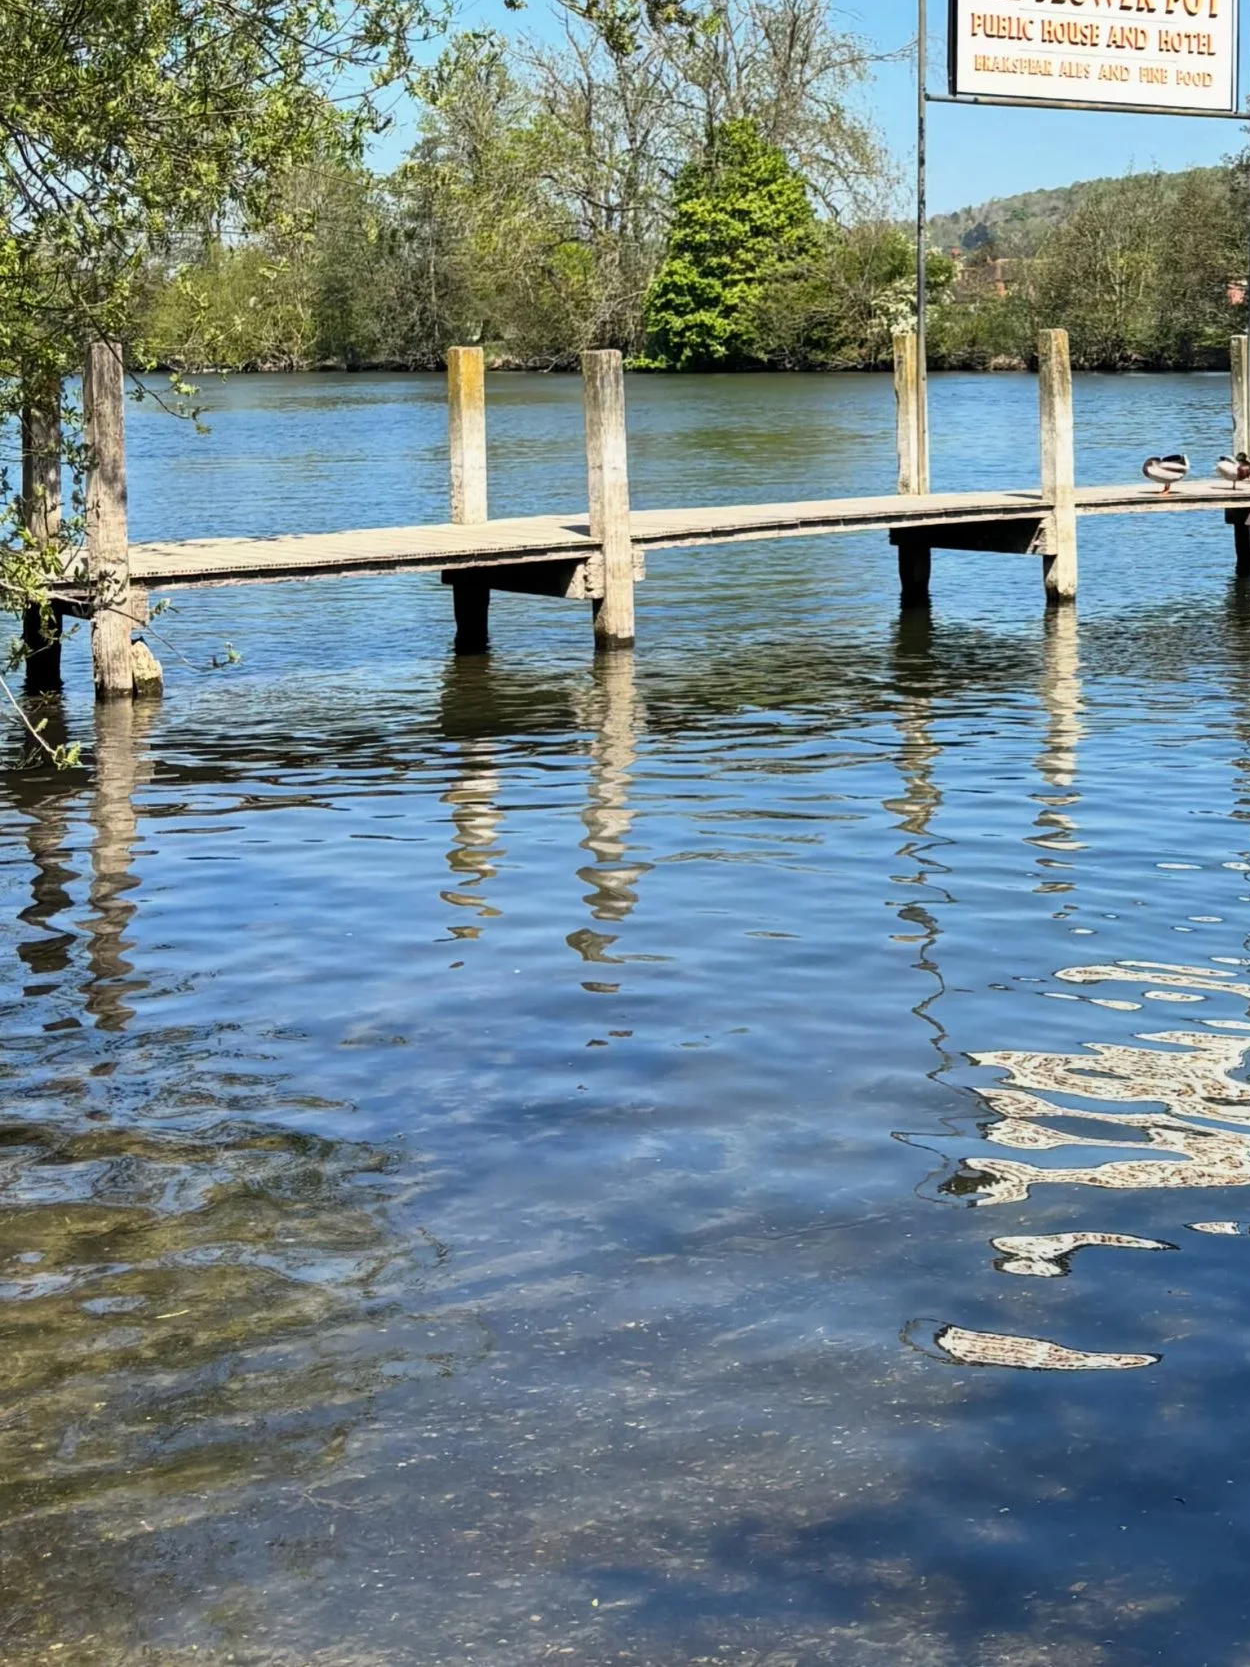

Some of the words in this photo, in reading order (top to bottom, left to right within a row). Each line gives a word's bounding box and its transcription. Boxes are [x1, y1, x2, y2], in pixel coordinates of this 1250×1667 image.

[971, 13, 1034, 41] PUBLIC
[1041, 19, 1099, 47] HOUSE
[1106, 26, 1147, 51] AND
[1158, 29, 1216, 56] HOTEL
[1097, 64, 1130, 82] AND
[1139, 66, 1168, 85] FINE
[1175, 69, 1213, 88] FOOD
